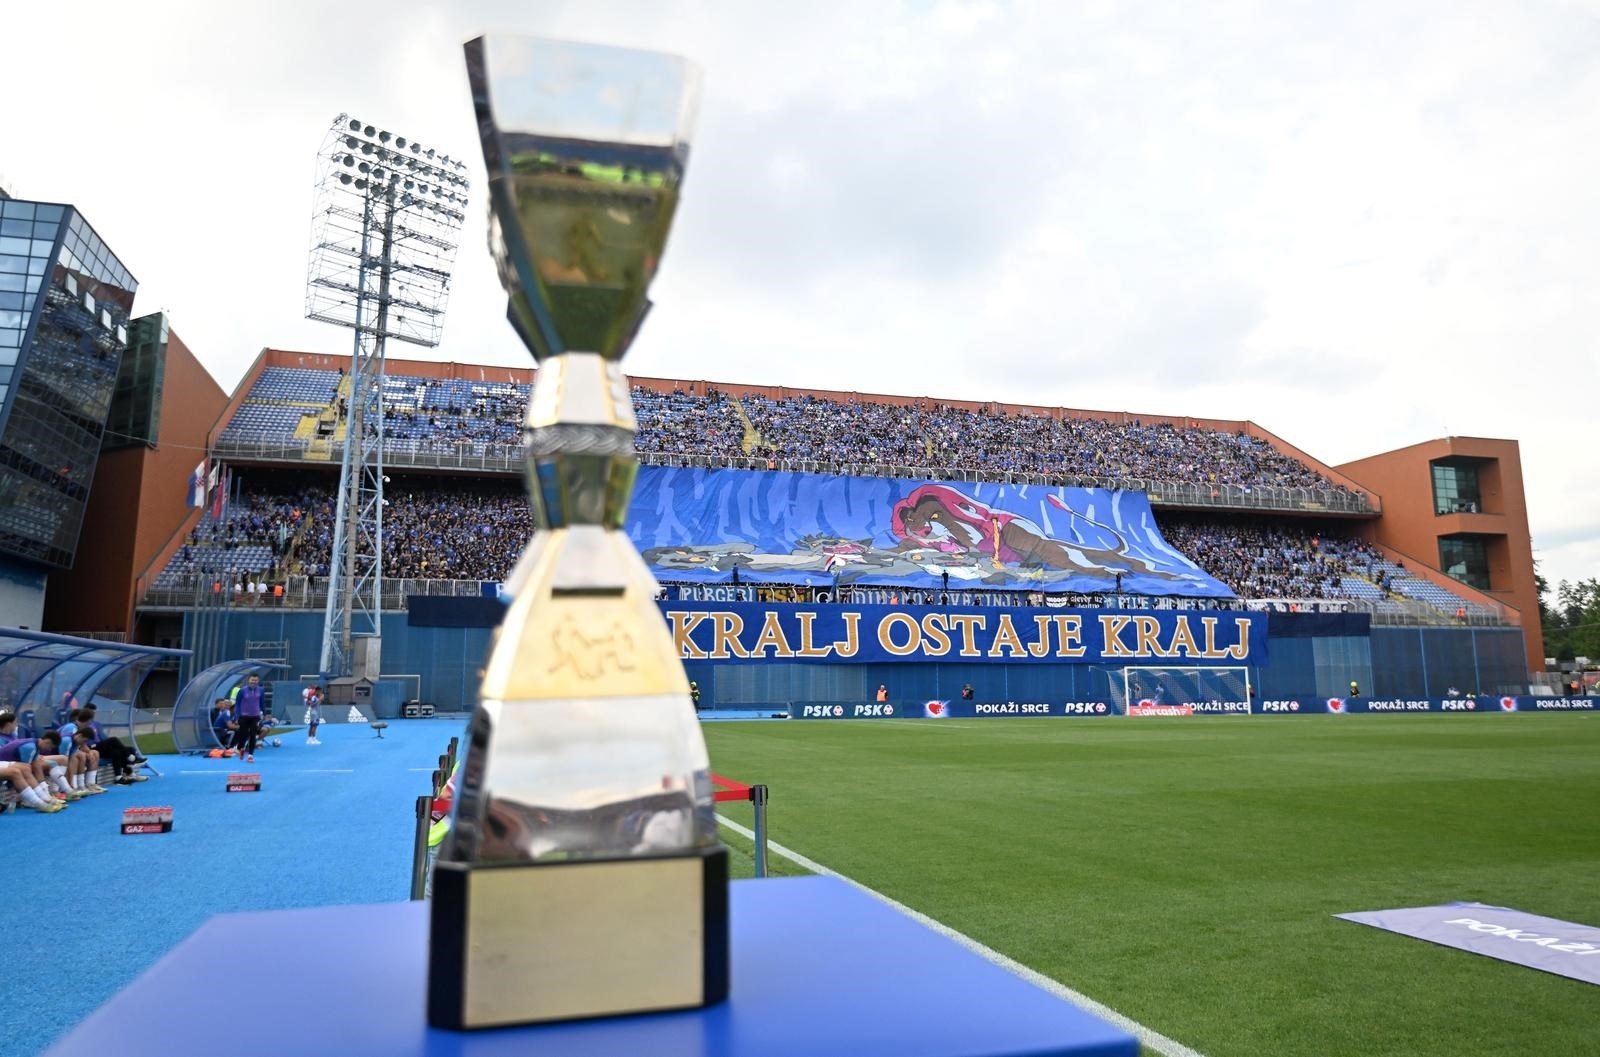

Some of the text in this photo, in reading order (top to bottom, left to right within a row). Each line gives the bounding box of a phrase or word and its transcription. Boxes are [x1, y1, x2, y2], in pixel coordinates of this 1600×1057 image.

[667, 611, 1251, 659] KRALJ OSTAJE KRALJ
[975, 701, 1049, 713] POKAŽI SRCE
[1065, 702, 1095, 713] PSK
[1223, 702, 1249, 711] SRCE
[1262, 700, 1290, 711] PSK
[1368, 699, 1430, 710] POKAŽI SRCE
[1441, 700, 1465, 710] PSK
[1536, 698, 1593, 709] POKAŽI SRCE
[803, 705, 833, 717] PSK
[854, 704, 883, 716] PSK
[126, 825, 144, 833] GAZ
